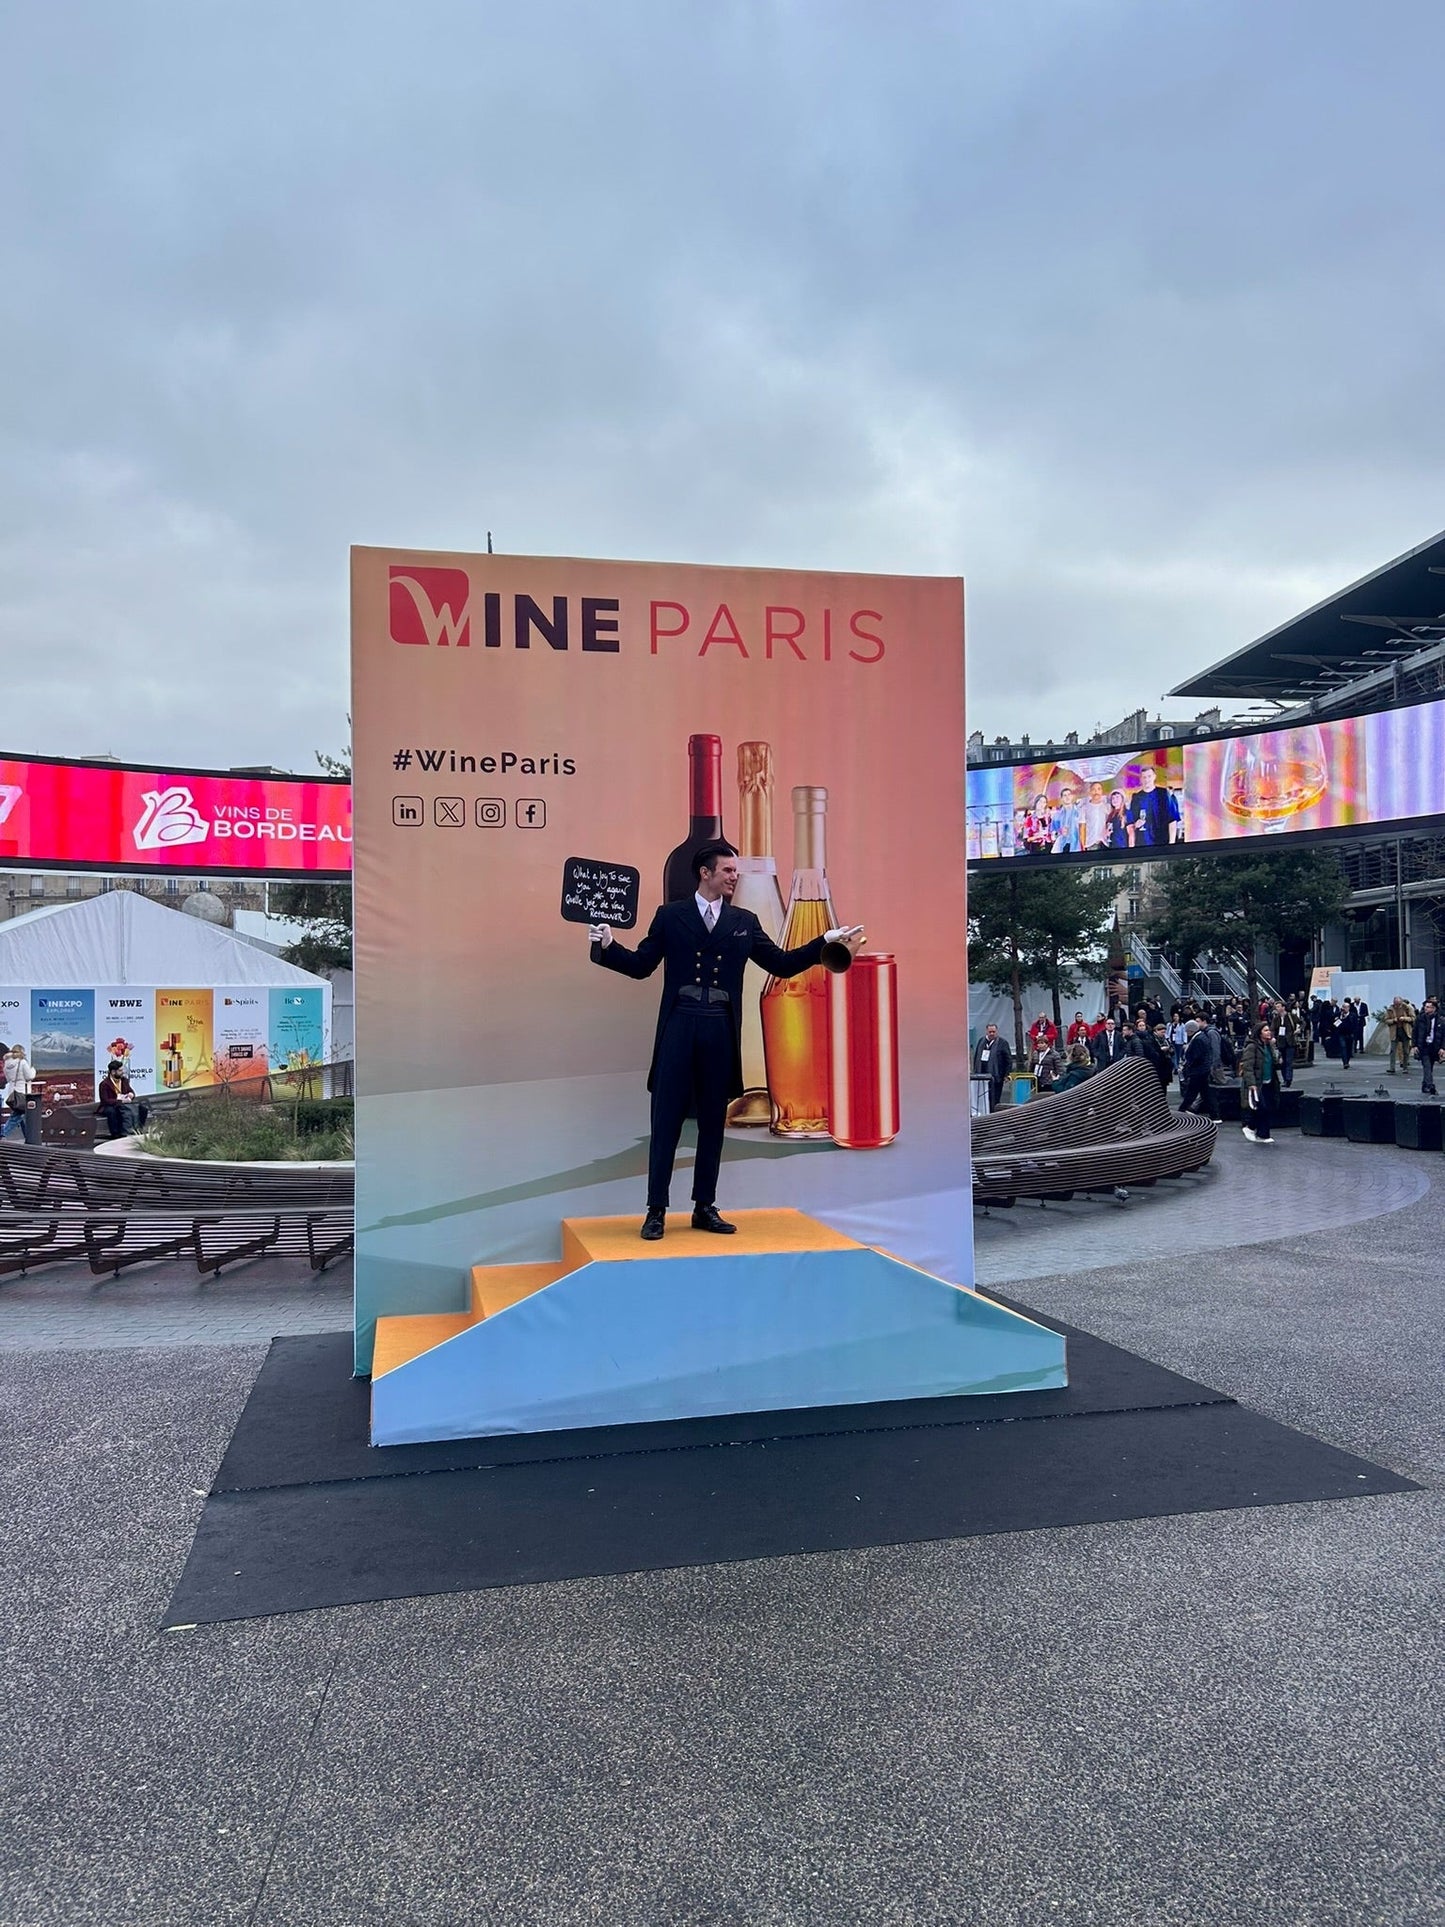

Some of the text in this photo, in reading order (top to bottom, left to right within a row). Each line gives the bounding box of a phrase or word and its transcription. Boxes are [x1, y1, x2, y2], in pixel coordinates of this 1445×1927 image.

[650, 601, 885, 664] PARIS
[393, 749, 576, 776] #WineParis
[214, 805, 292, 821] VINS DE
[573, 865, 590, 879] What
[617, 874, 632, 883] see
[576, 882, 631, 899] you again
[109, 1000, 143, 1008] WBWE
